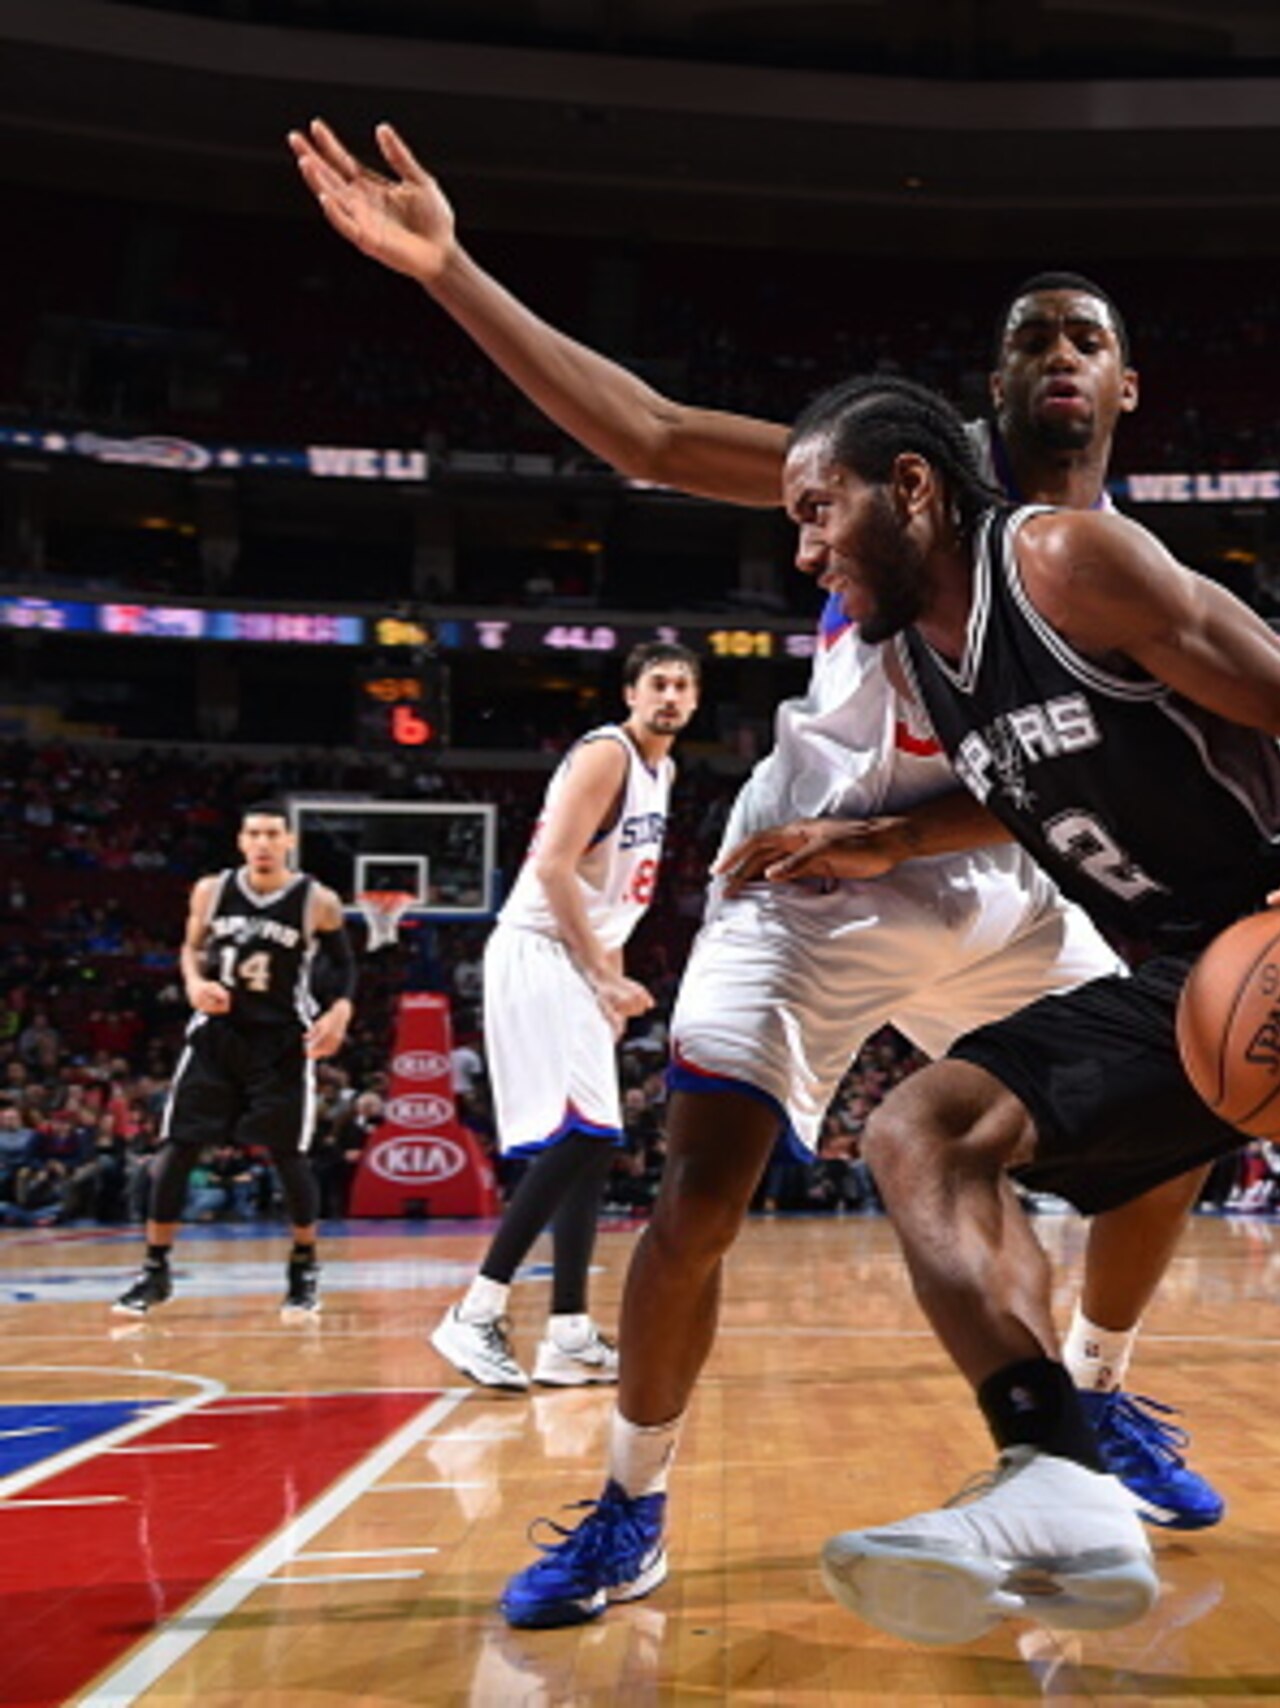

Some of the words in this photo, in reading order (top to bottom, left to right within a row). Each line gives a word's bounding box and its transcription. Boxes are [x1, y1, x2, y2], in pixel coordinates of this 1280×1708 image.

[306, 445, 380, 477] WE
[1127, 473, 1191, 501] WE
[1196, 471, 1280, 500] LIVE
[707, 630, 773, 657] 101
[954, 691, 1103, 806] PURS
[1043, 808, 1168, 900] 2
[218, 947, 273, 992] 14
[387, 1145, 447, 1173] KIA
